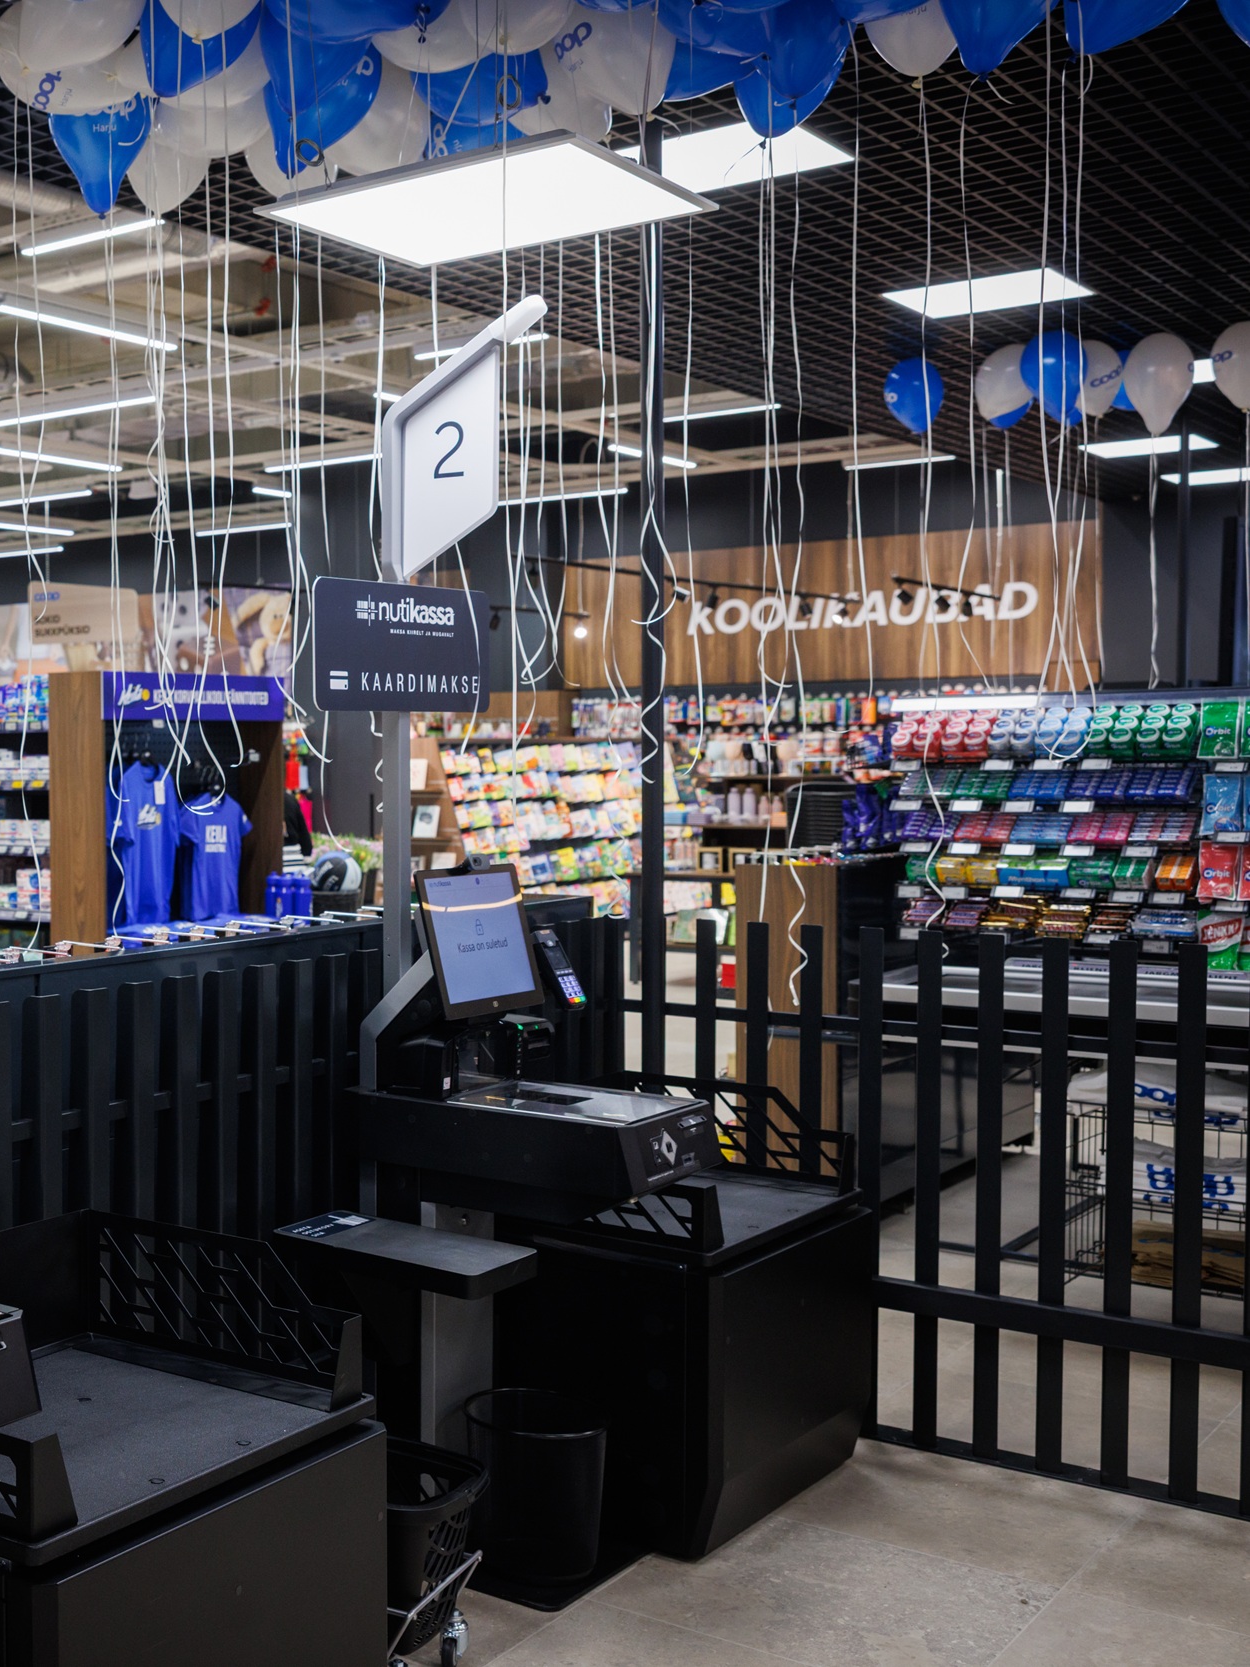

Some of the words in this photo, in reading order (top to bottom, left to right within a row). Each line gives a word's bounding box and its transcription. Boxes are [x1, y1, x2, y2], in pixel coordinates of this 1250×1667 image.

[433, 421, 464, 479] 2
[378, 598, 455, 626] nutikassa
[361, 672, 479, 694] KAARDIMAKSE
[1205, 726, 1231, 737] Orbit
[1203, 868, 1231, 880] Orbit
[457, 943, 476, 954] Kassa
[476, 942, 485, 951] on
[486, 937, 508, 949] suletud
